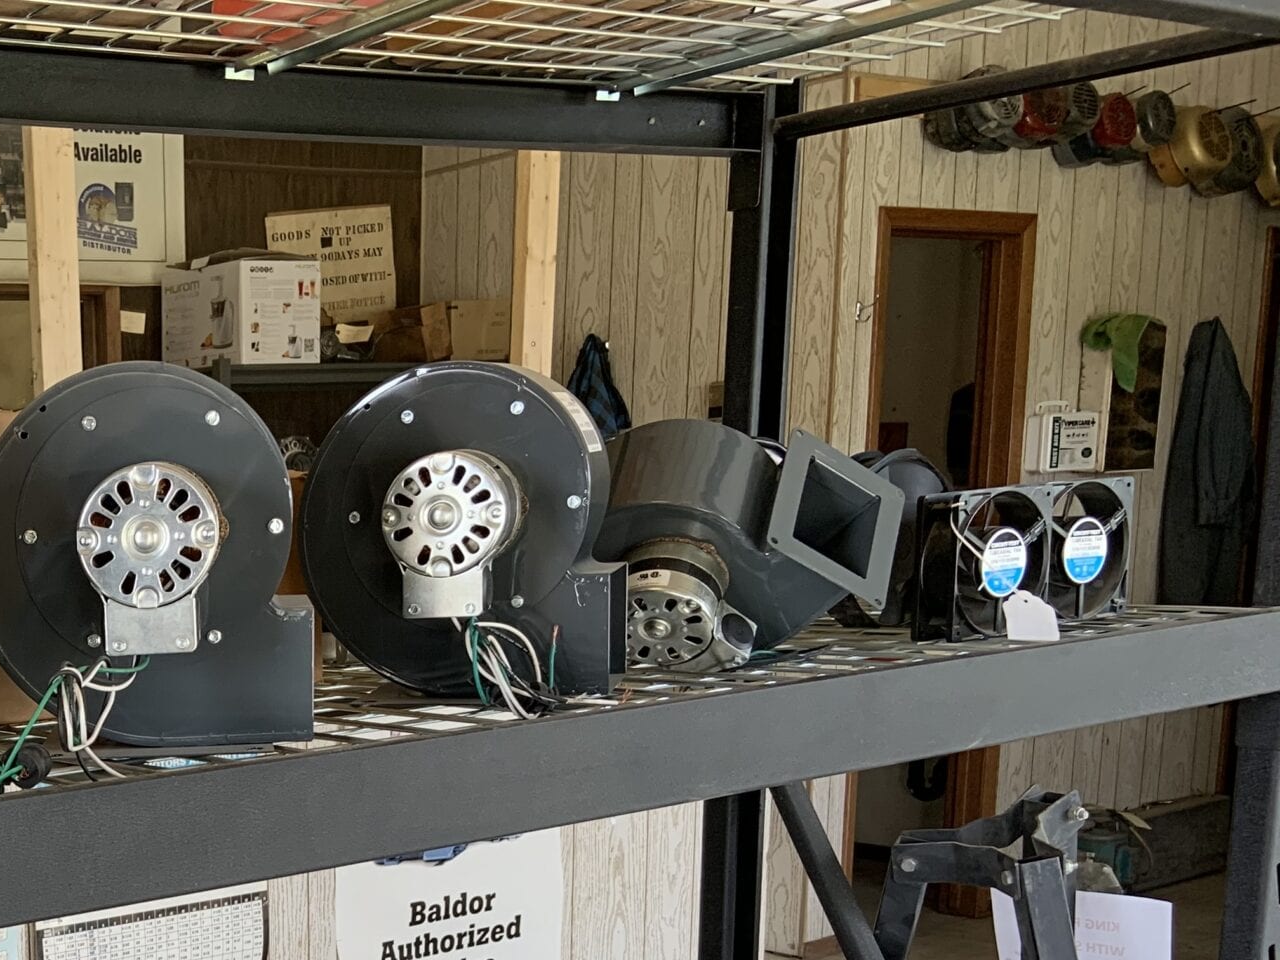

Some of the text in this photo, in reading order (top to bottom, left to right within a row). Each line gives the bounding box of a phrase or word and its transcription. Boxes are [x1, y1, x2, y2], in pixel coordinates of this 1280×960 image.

[74, 141, 143, 163] Available
[271, 222, 384, 243] GOODS NOT PICKED
[82, 240, 132, 255] DISTRIBUTOR
[339, 237, 352, 247] UP
[362, 246, 384, 257] MAY
[164, 279, 200, 296] Hurom
[321, 275, 348, 286] OSED
[321, 295, 386, 312] THER NOTICE
[409, 892, 496, 926] Baldor
